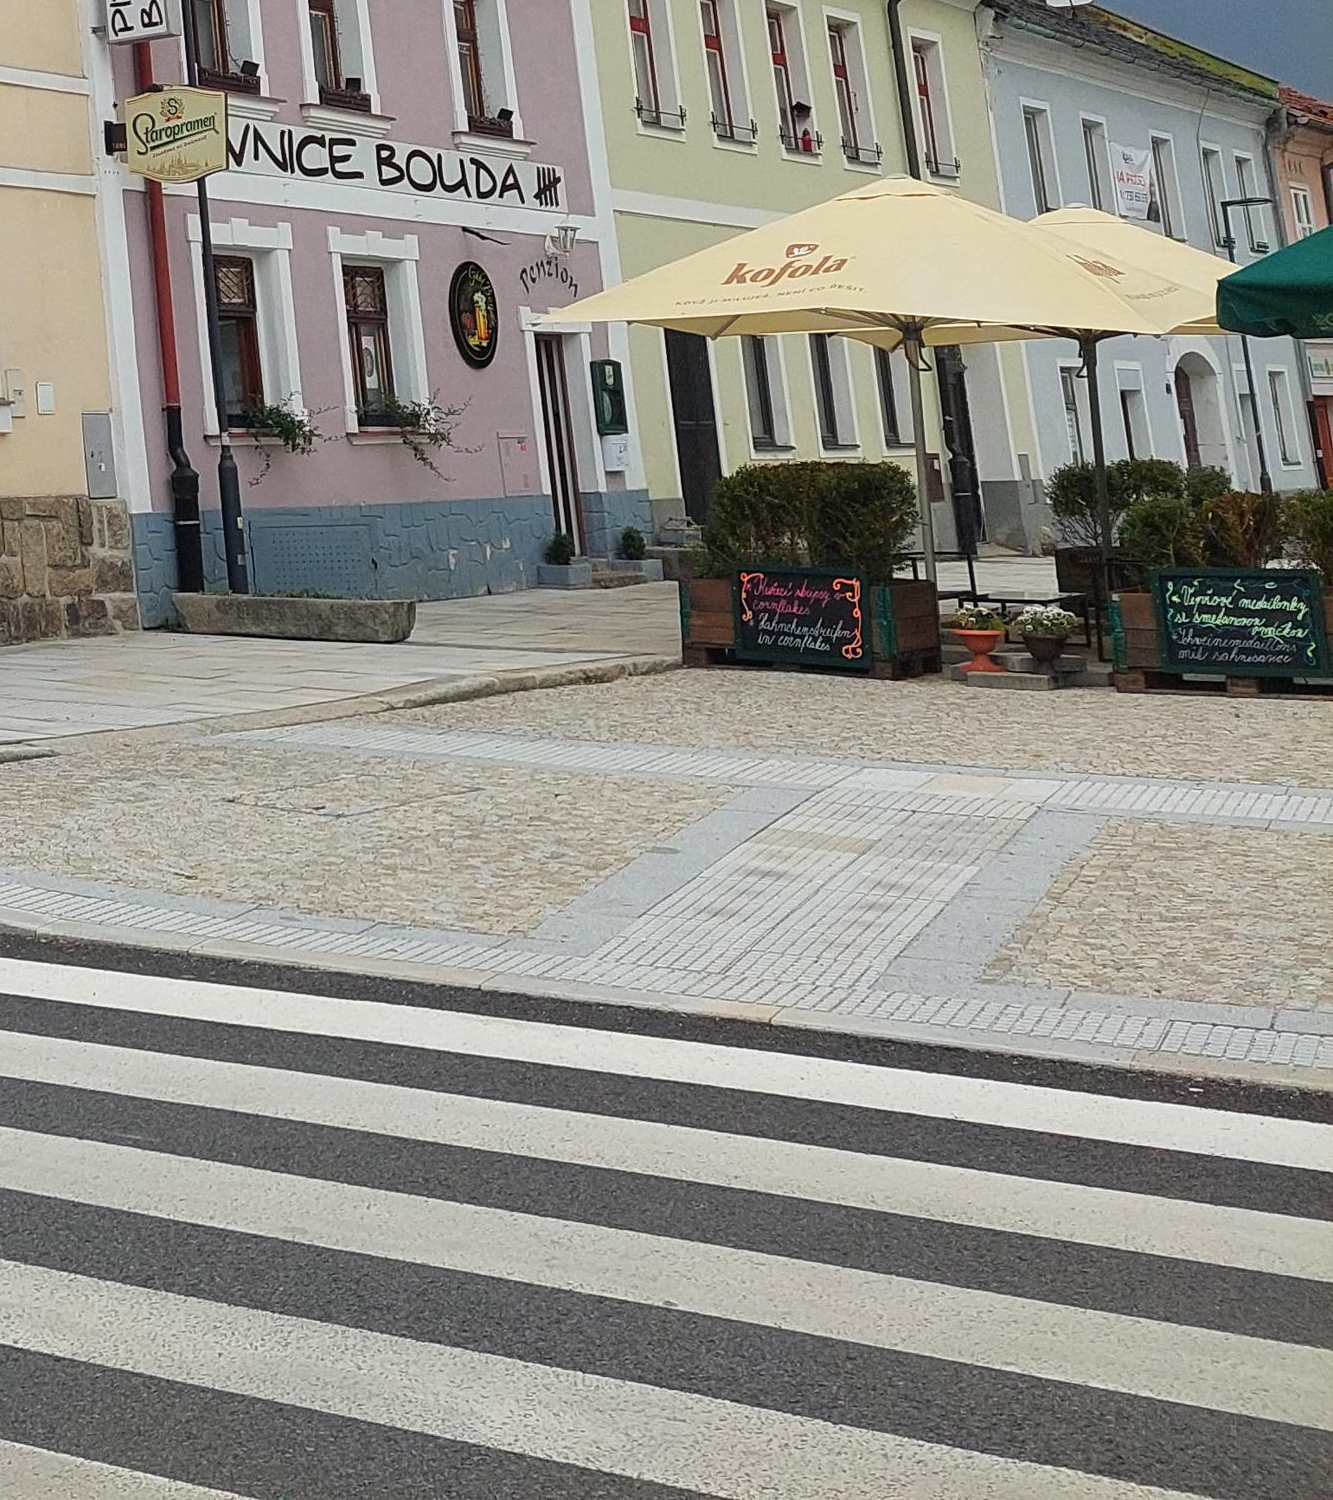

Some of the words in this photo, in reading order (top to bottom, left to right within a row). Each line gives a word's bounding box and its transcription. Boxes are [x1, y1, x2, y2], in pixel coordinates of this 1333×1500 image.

[133, 112, 216, 155] Staropramen
[227, 123, 364, 179] VNICE
[375, 143, 525, 204] BOUDA
[721, 255, 848, 288] kofola
